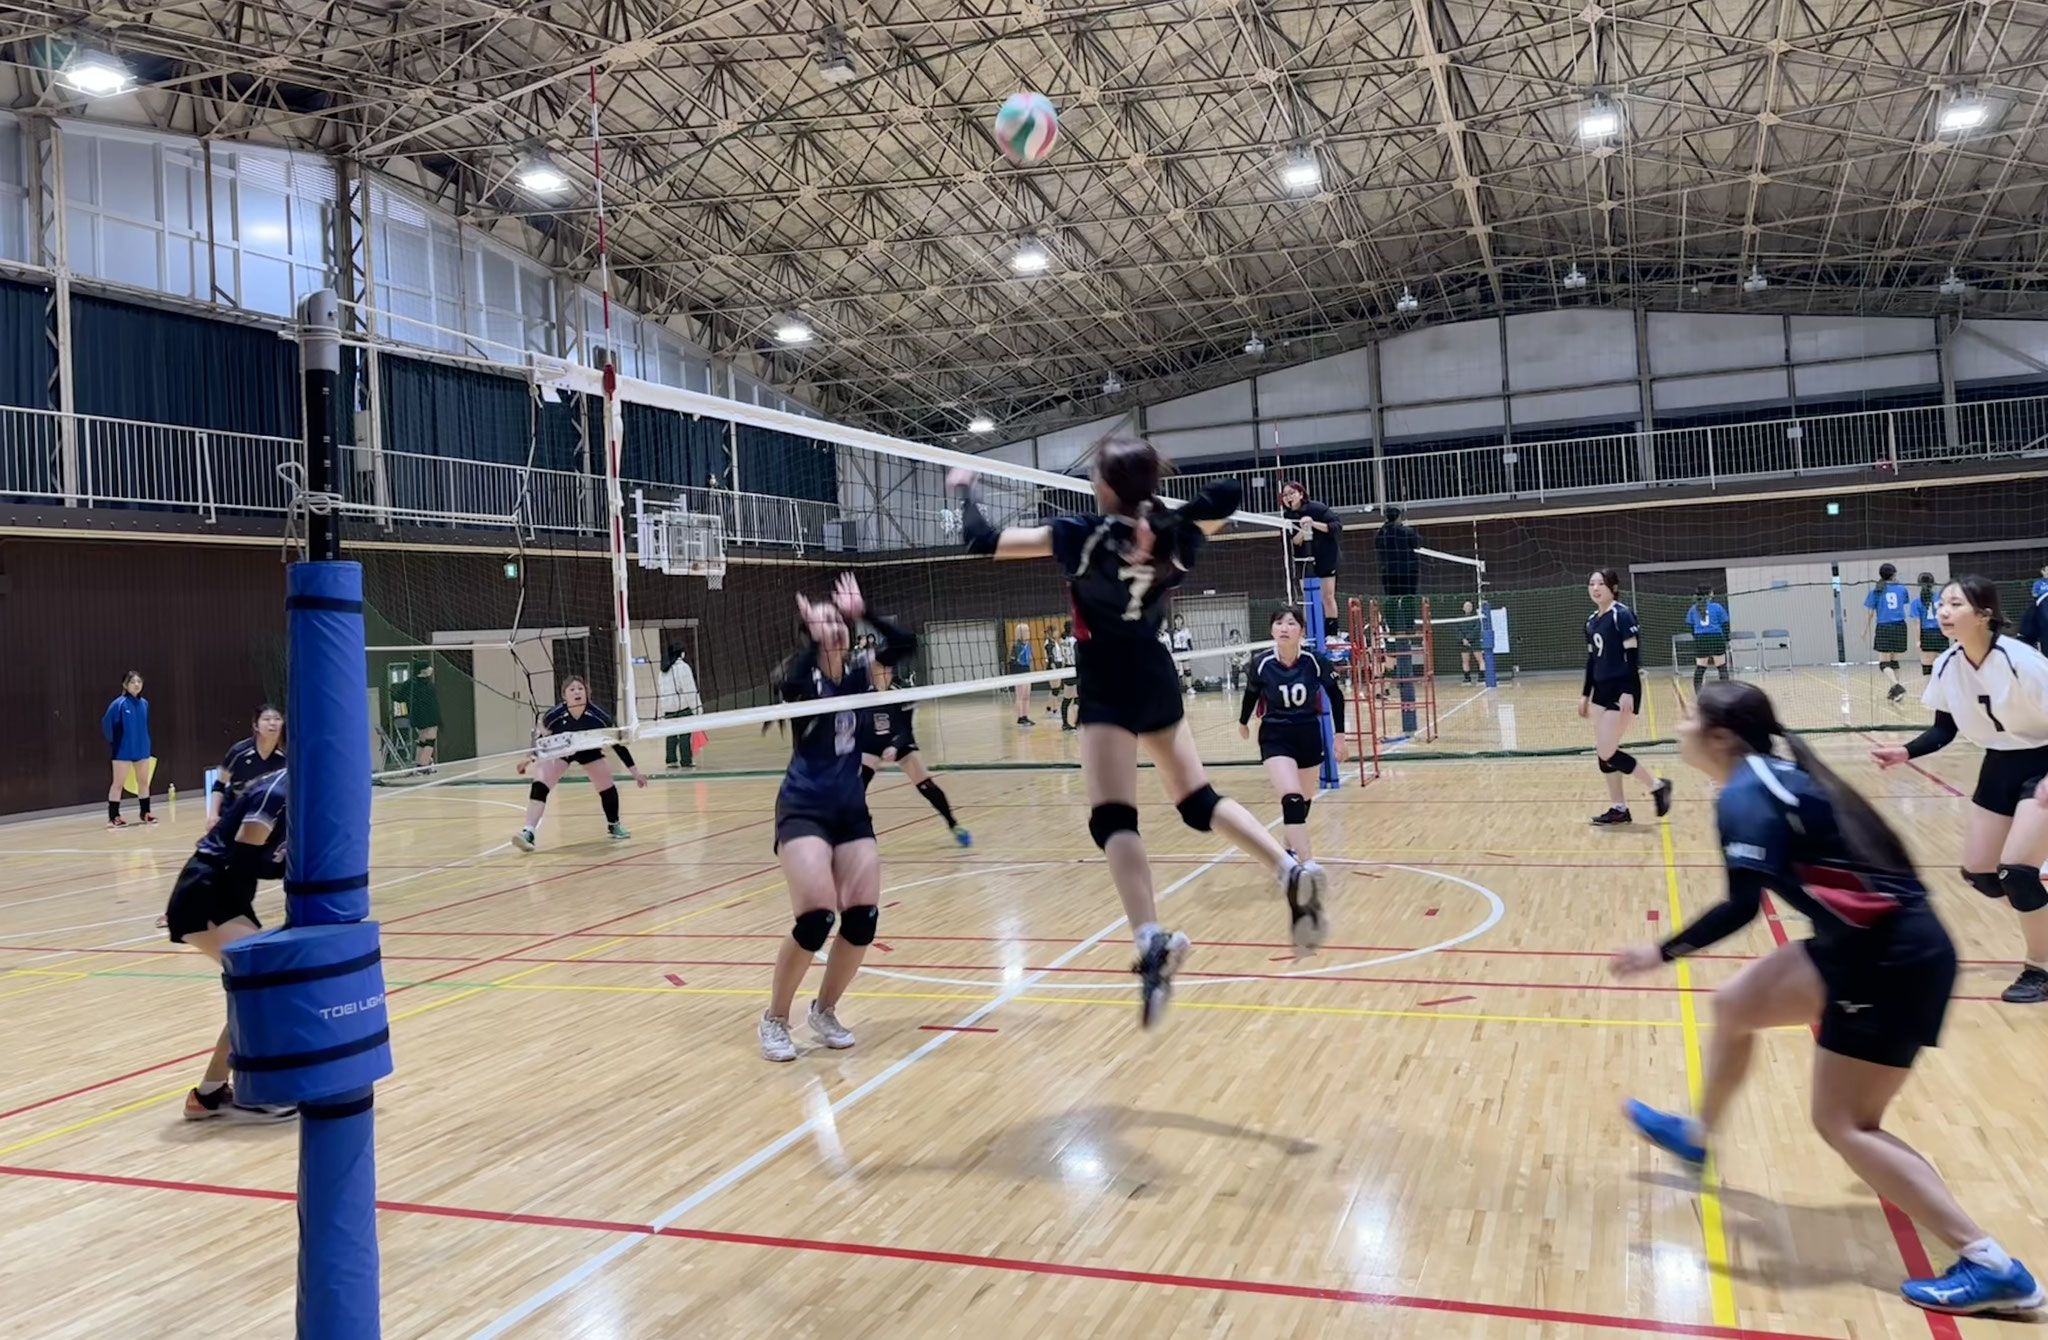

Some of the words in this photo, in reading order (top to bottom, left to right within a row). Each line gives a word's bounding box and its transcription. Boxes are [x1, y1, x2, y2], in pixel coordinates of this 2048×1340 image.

[1118, 564, 1156, 621] 7
[1885, 592, 1898, 610] 9
[1593, 632, 1604, 657] 9
[1278, 683, 1307, 708] 10
[1978, 694, 2005, 733] 7
[319, 1002, 357, 1019] TOEI
[359, 993, 385, 1011] LIGH
